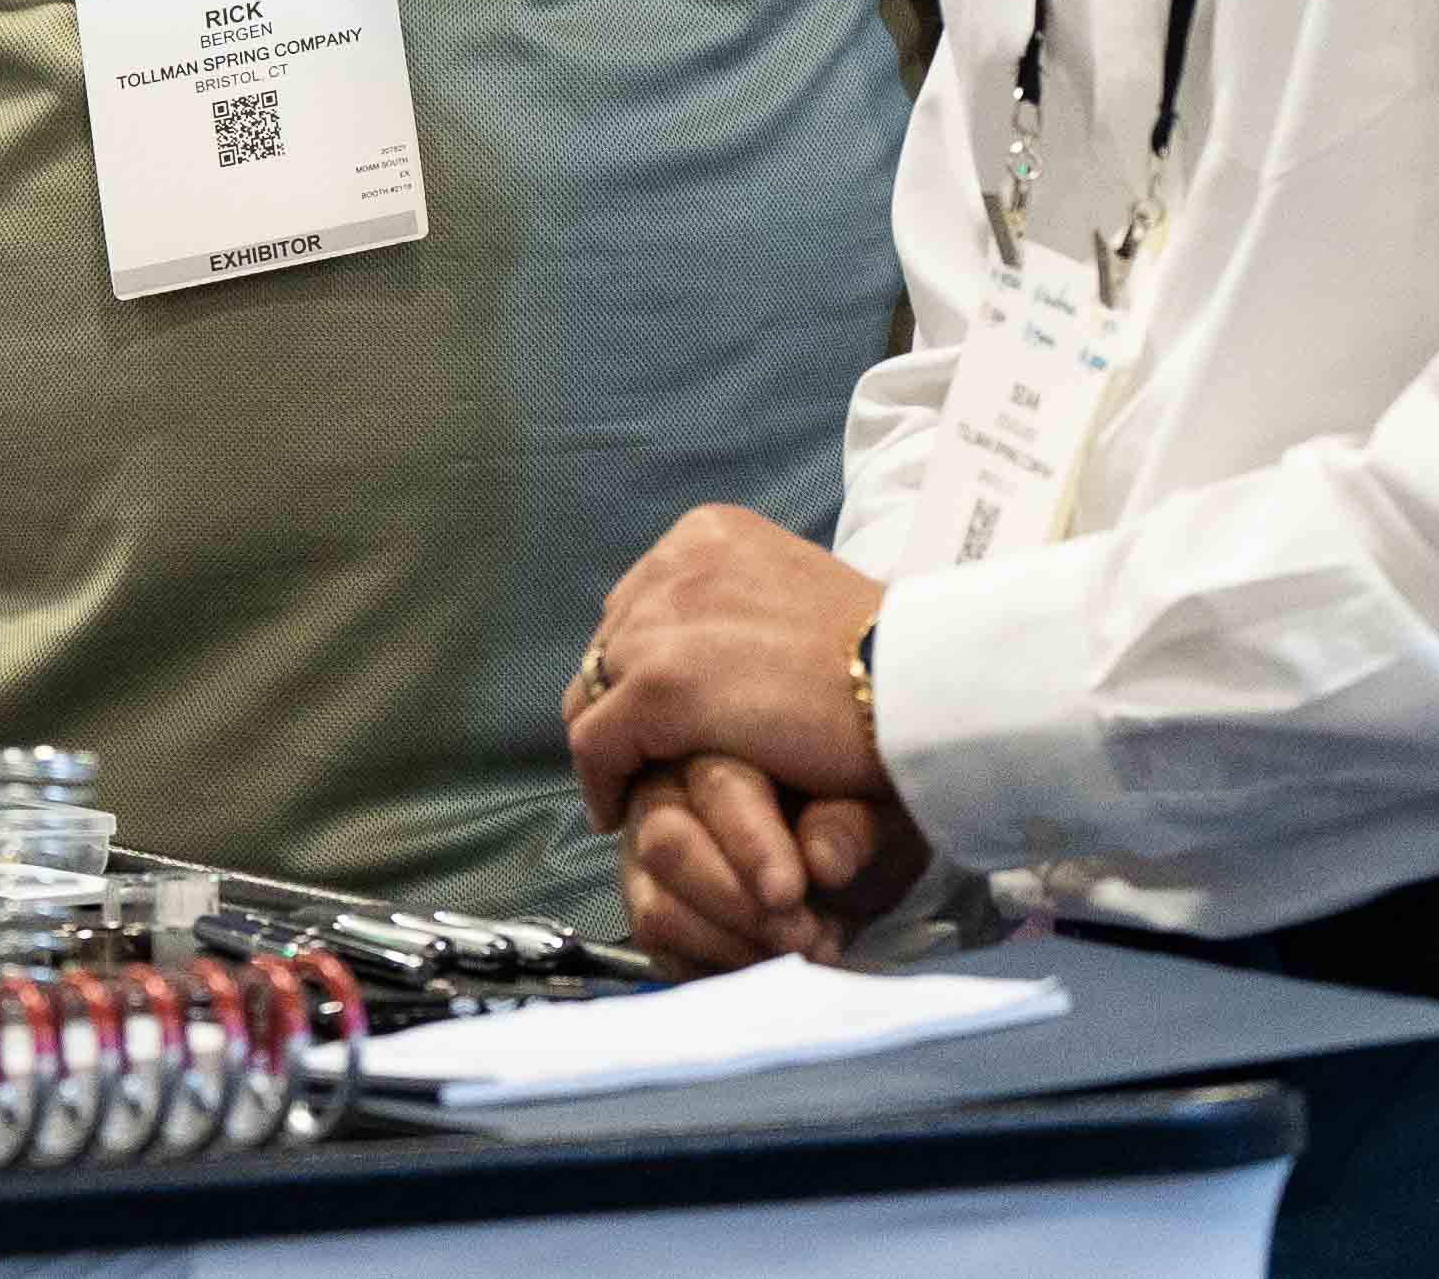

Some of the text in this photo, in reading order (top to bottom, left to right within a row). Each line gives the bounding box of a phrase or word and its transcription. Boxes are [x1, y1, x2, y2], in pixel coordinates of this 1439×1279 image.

[205, 0, 264, 29] RICK
[199, 21, 274, 49] BERGEN
[115, 27, 363, 90] TOLLMAN SPRING COMPANY
[195, 63, 289, 94] BRISTOL, CT
[209, 234, 322, 272] EXHIBITOR
